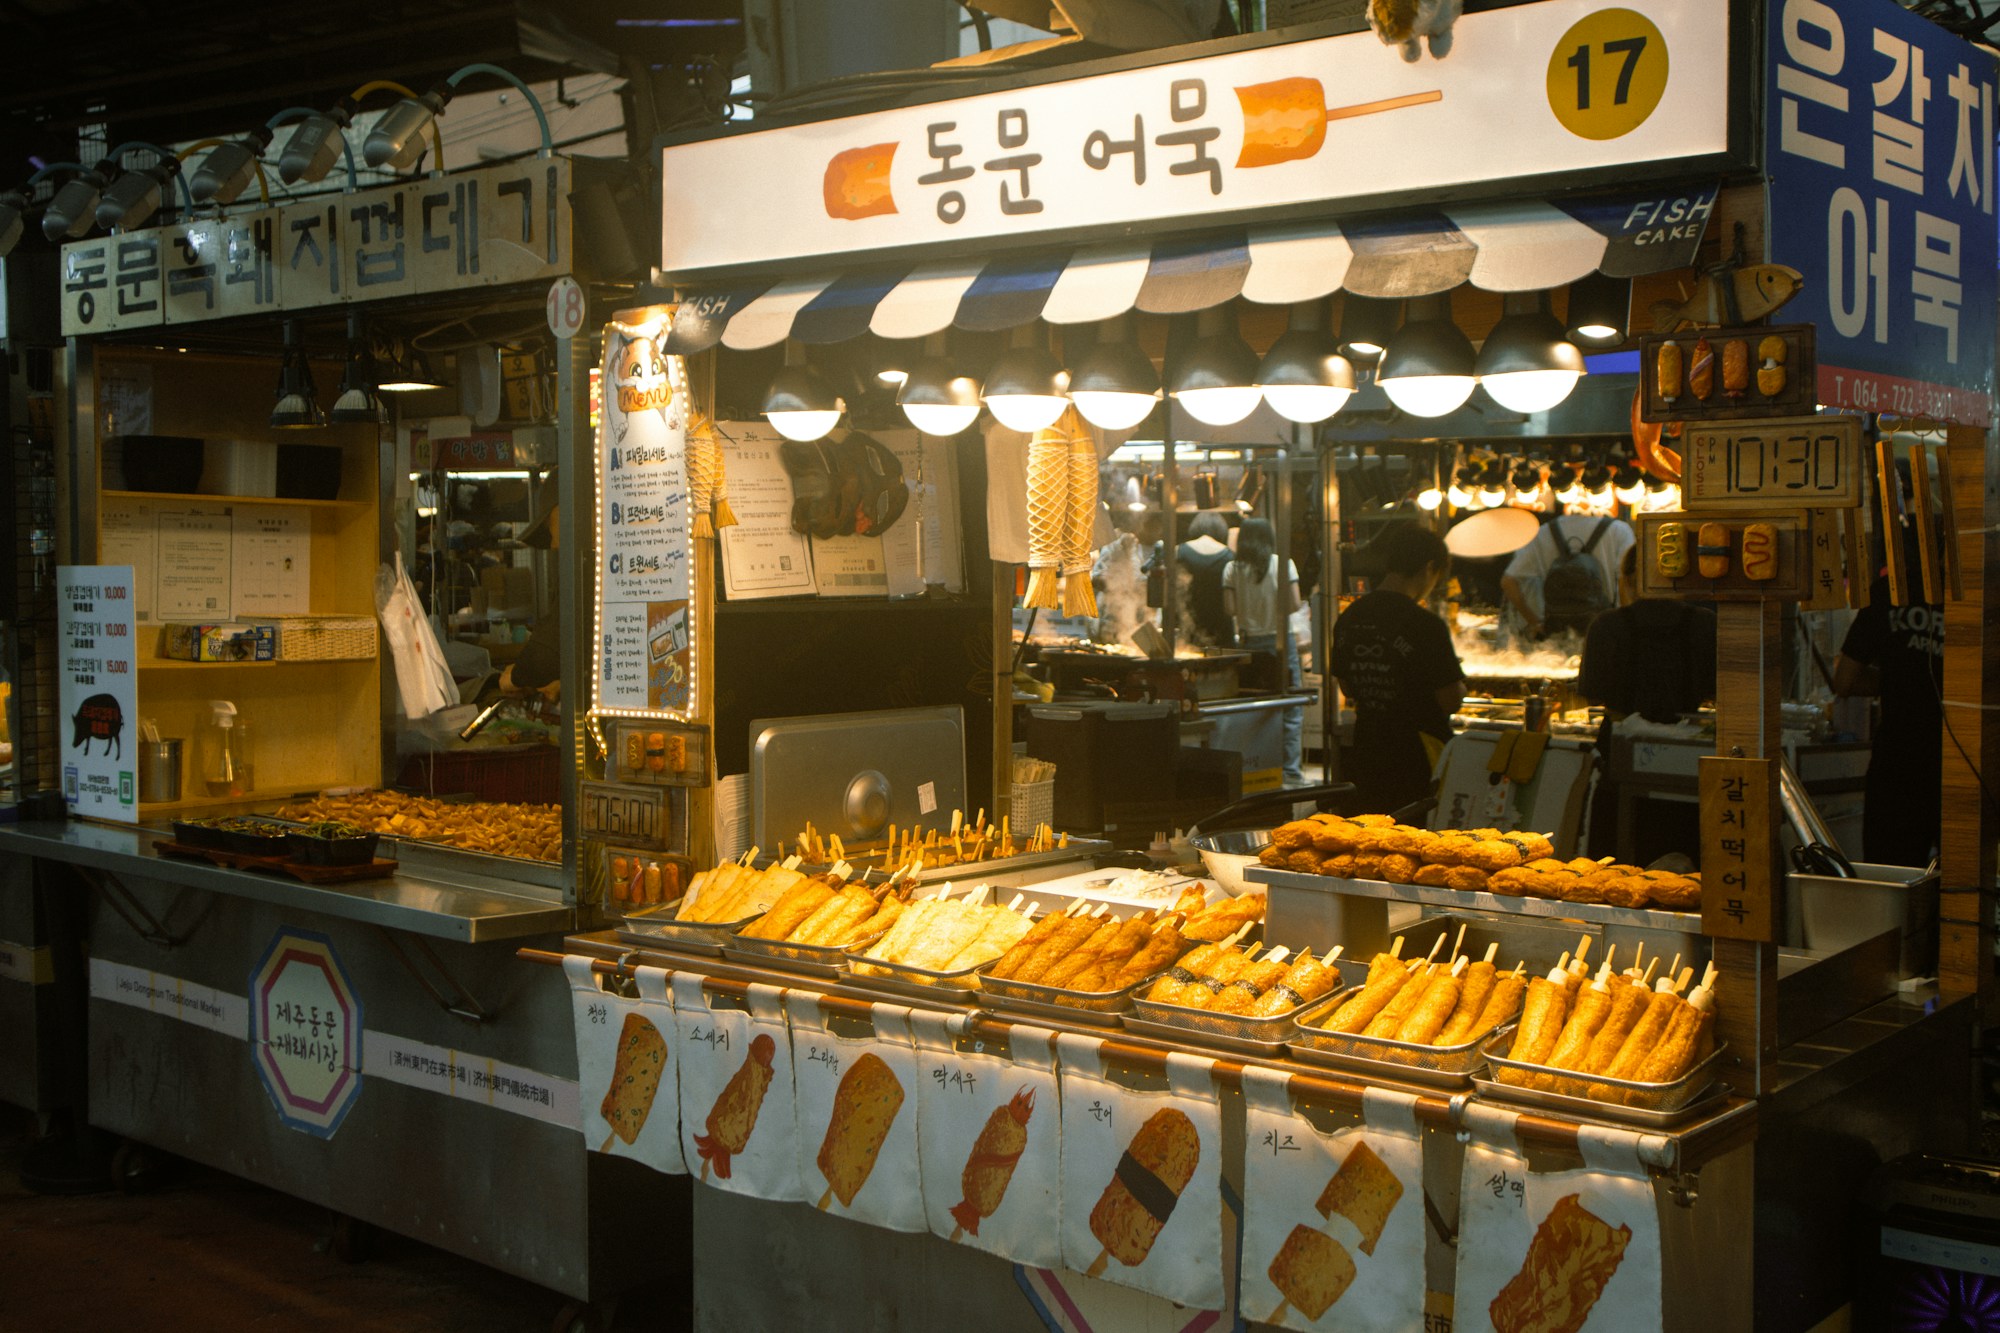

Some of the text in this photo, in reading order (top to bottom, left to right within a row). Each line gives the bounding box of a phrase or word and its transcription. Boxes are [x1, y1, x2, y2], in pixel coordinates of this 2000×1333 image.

[1568, 36, 1647, 110] 17
[1777, 0, 1993, 215] 은갈치
[918, 78, 1221, 225] 동문 어묵
[1623, 196, 1715, 229] FISH
[1634, 223, 1699, 246] CAKE
[1828, 187, 1962, 364] 어묵
[548, 286, 582, 330] 18
[622, 386, 669, 408] MENU
[1696, 437, 1705, 496] CLOSE
[1726, 435, 1840, 493] 10:30
[104, 586, 126, 600] 10,000
[105, 623, 127, 637] 10,000
[107, 660, 128, 674] 15,000
[120, 979, 221, 1018] Jeju Dongmun Traditional Market
[588, 1003, 607, 1024] 청양
[276, 1001, 337, 1039] 제주동문
[277, 1033, 338, 1073] 재래시장
[690, 1025, 729, 1051] 소세지
[933, 1064, 976, 1094] 딱새우
[1088, 1101, 1113, 1128] 문어
[1262, 1129, 1301, 1156] 치즈
[1485, 1170, 1525, 1208] 쌀떡
